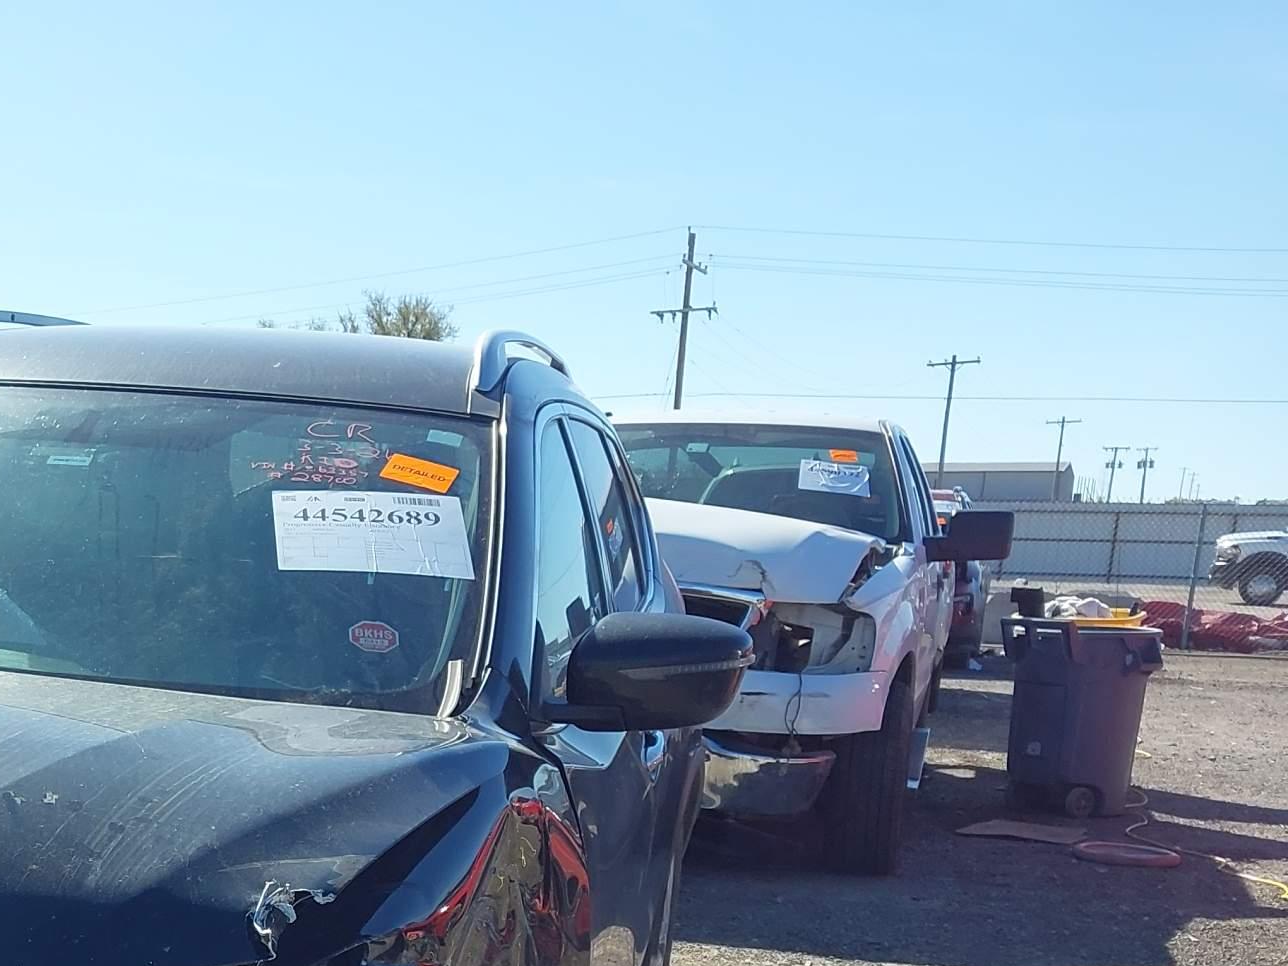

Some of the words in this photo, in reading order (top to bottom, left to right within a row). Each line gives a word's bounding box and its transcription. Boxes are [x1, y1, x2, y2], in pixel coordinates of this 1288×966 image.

[392, 464, 447, 482] DETAILED
[293, 507, 441, 527] 44542689
[354, 628, 393, 640] BKHS
